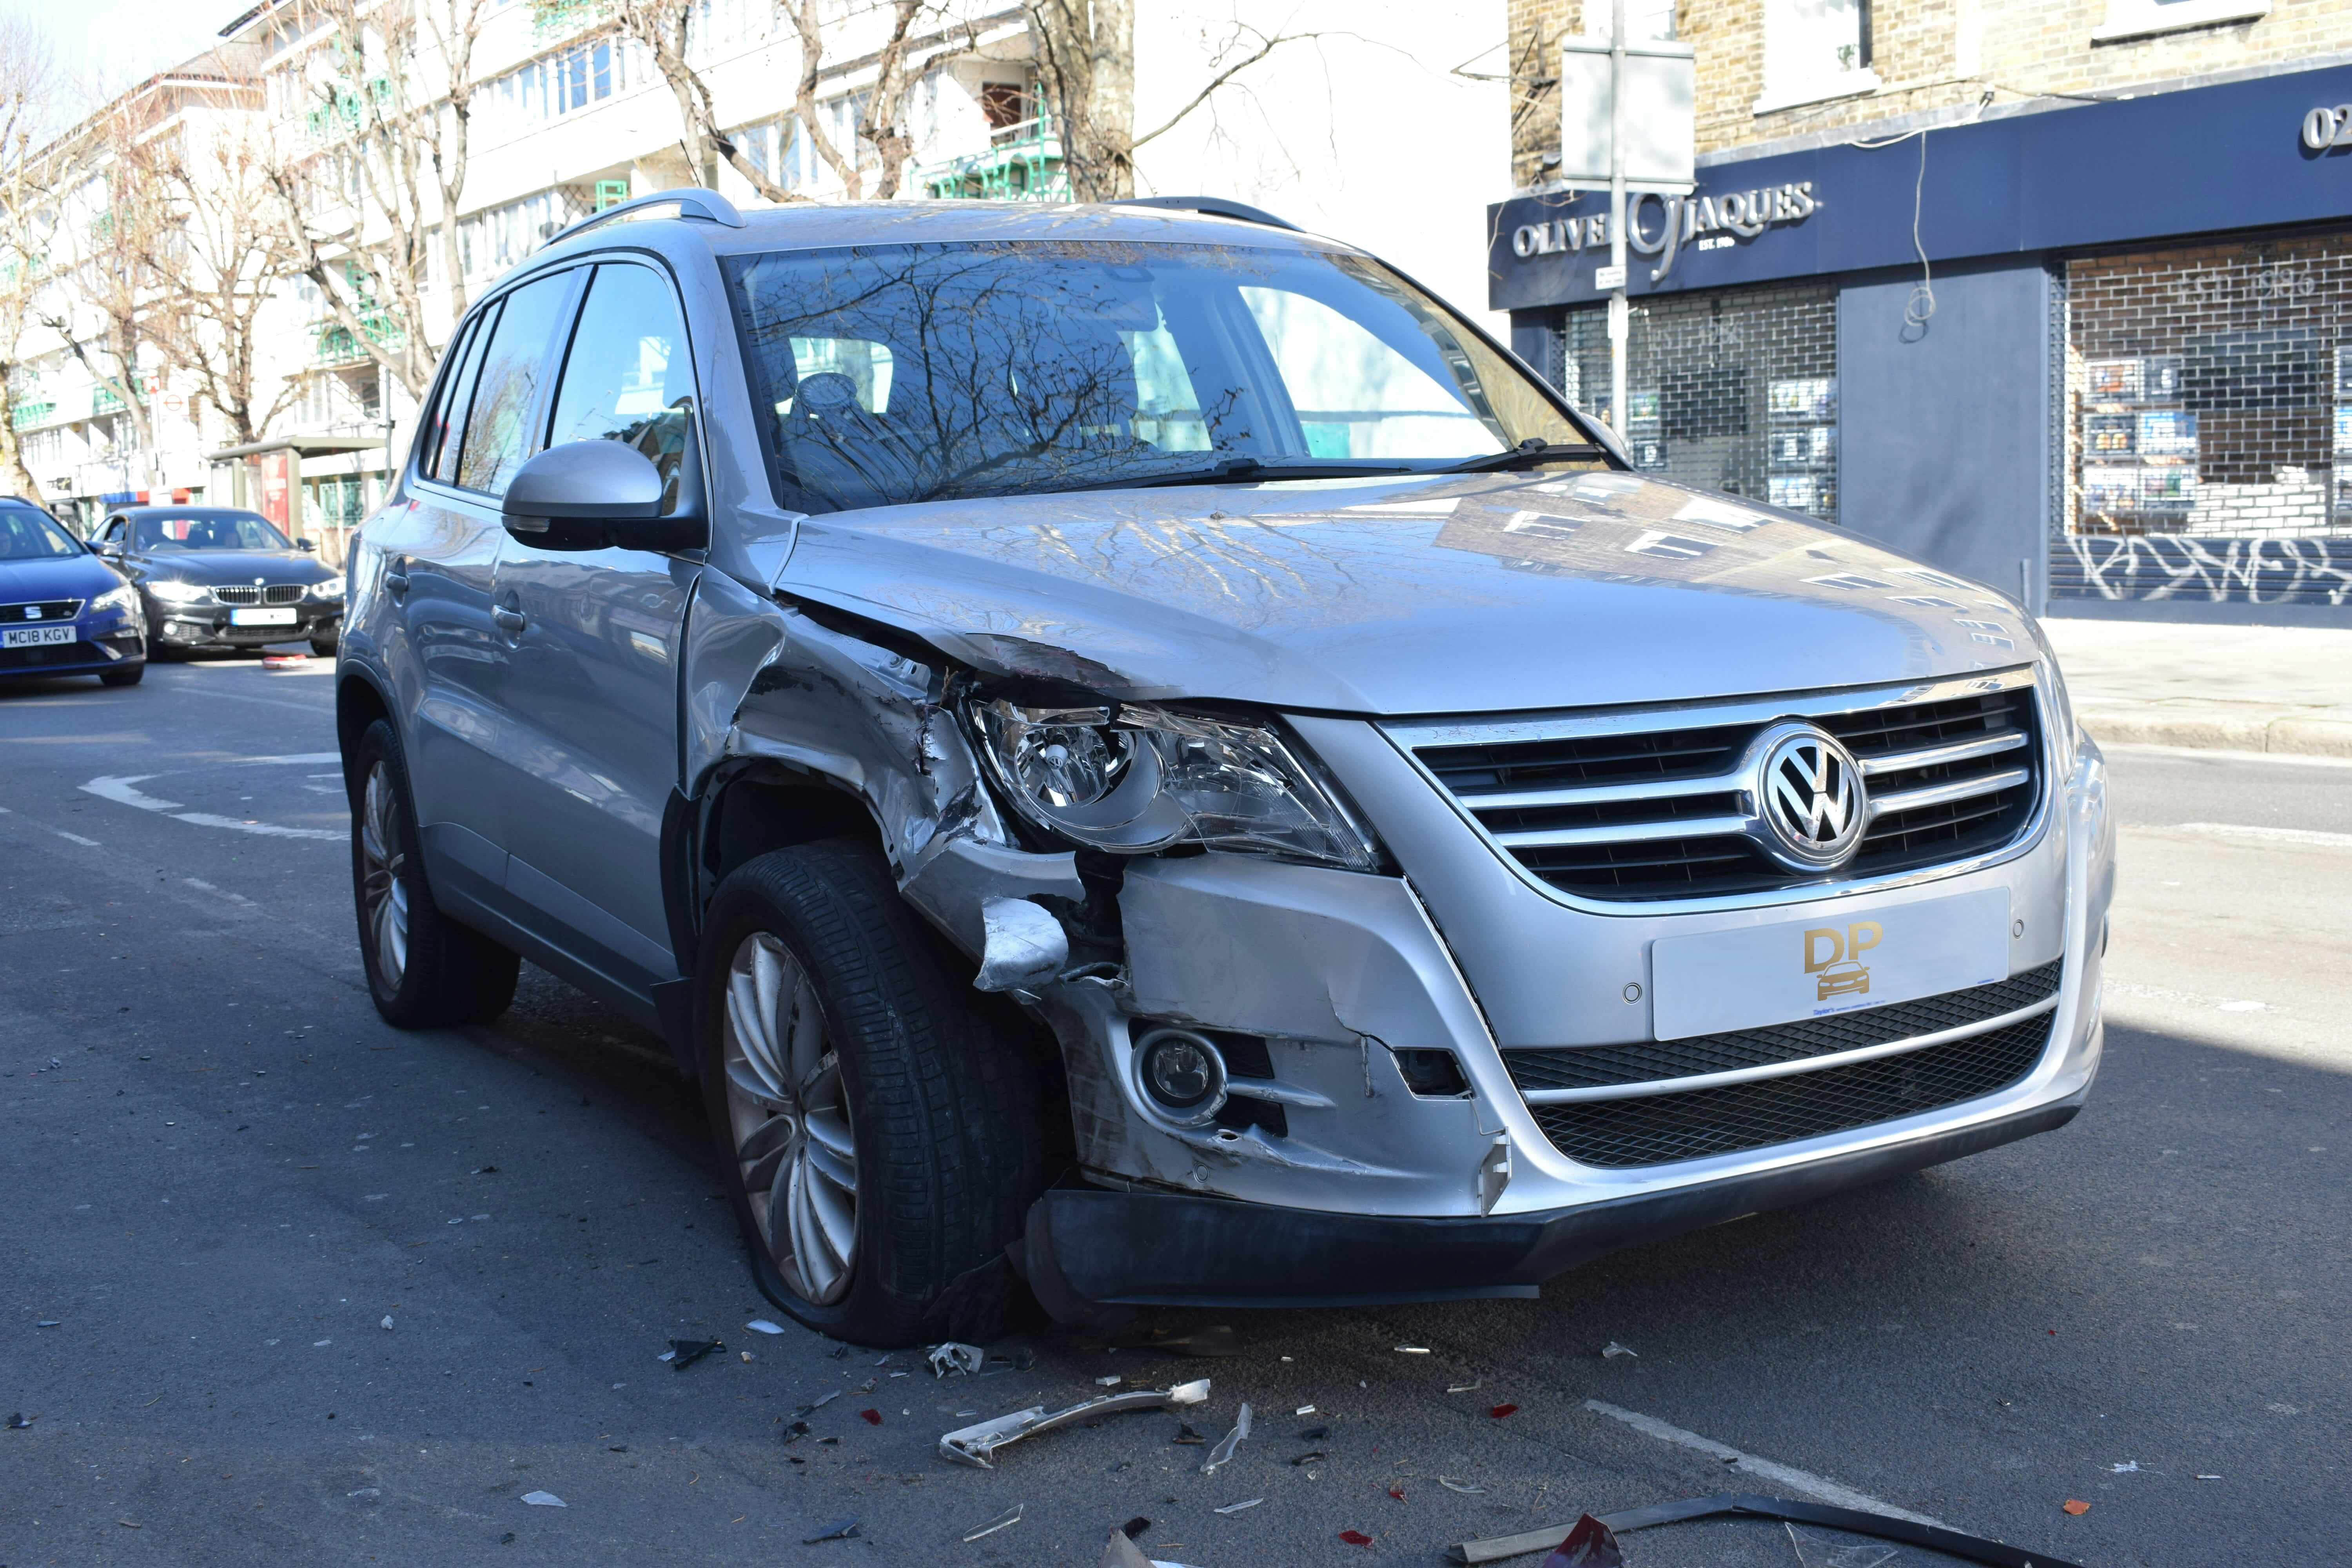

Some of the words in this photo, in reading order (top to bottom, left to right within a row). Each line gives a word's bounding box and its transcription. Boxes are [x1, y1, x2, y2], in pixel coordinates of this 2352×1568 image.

[1513, 213, 1628, 257] OLIVE
[1681, 182, 1814, 242] JAQUES
[9, 630, 40, 644] MC18
[44, 628, 69, 642] KGV
[1767, 737, 1863, 851] VW
